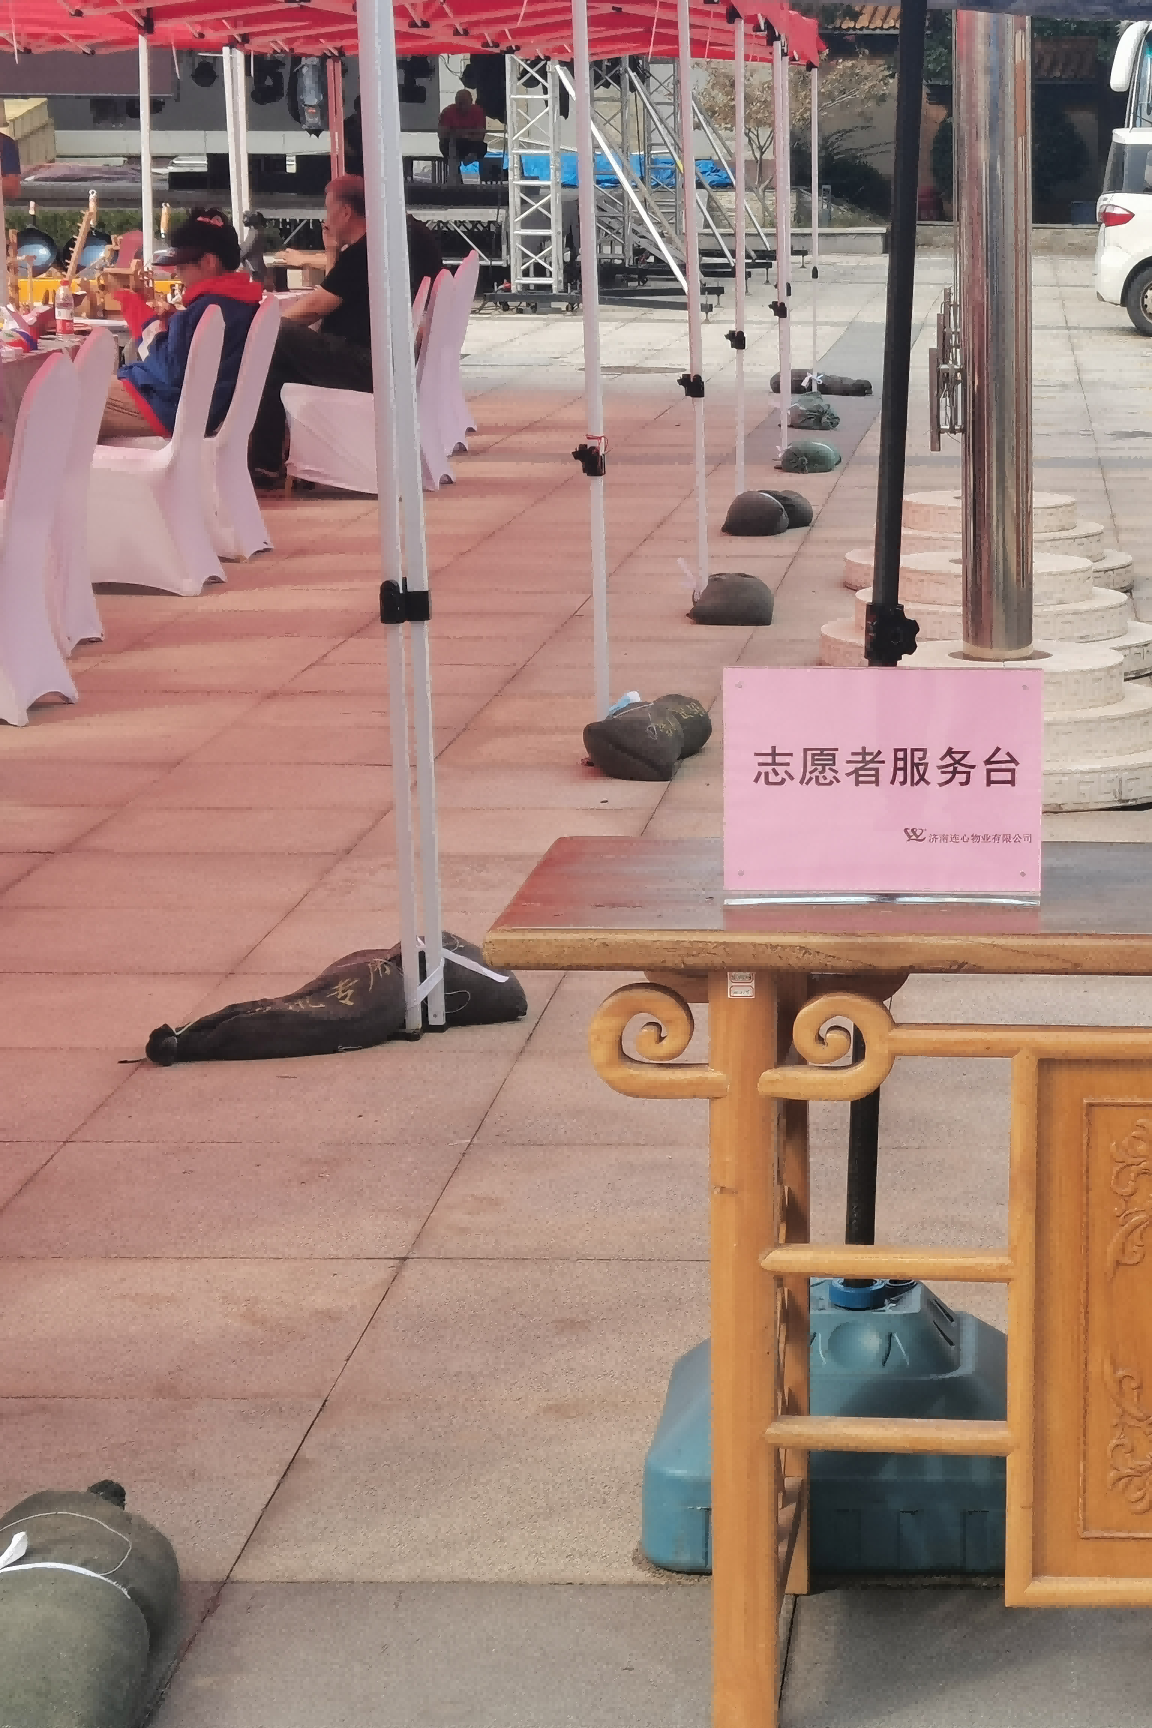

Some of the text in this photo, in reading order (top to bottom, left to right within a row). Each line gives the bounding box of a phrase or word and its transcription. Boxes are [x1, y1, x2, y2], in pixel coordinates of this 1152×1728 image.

[753, 745, 1020, 788] 志愿者服务台
[928, 833, 1033, 844] 济南连心物业有限公司
